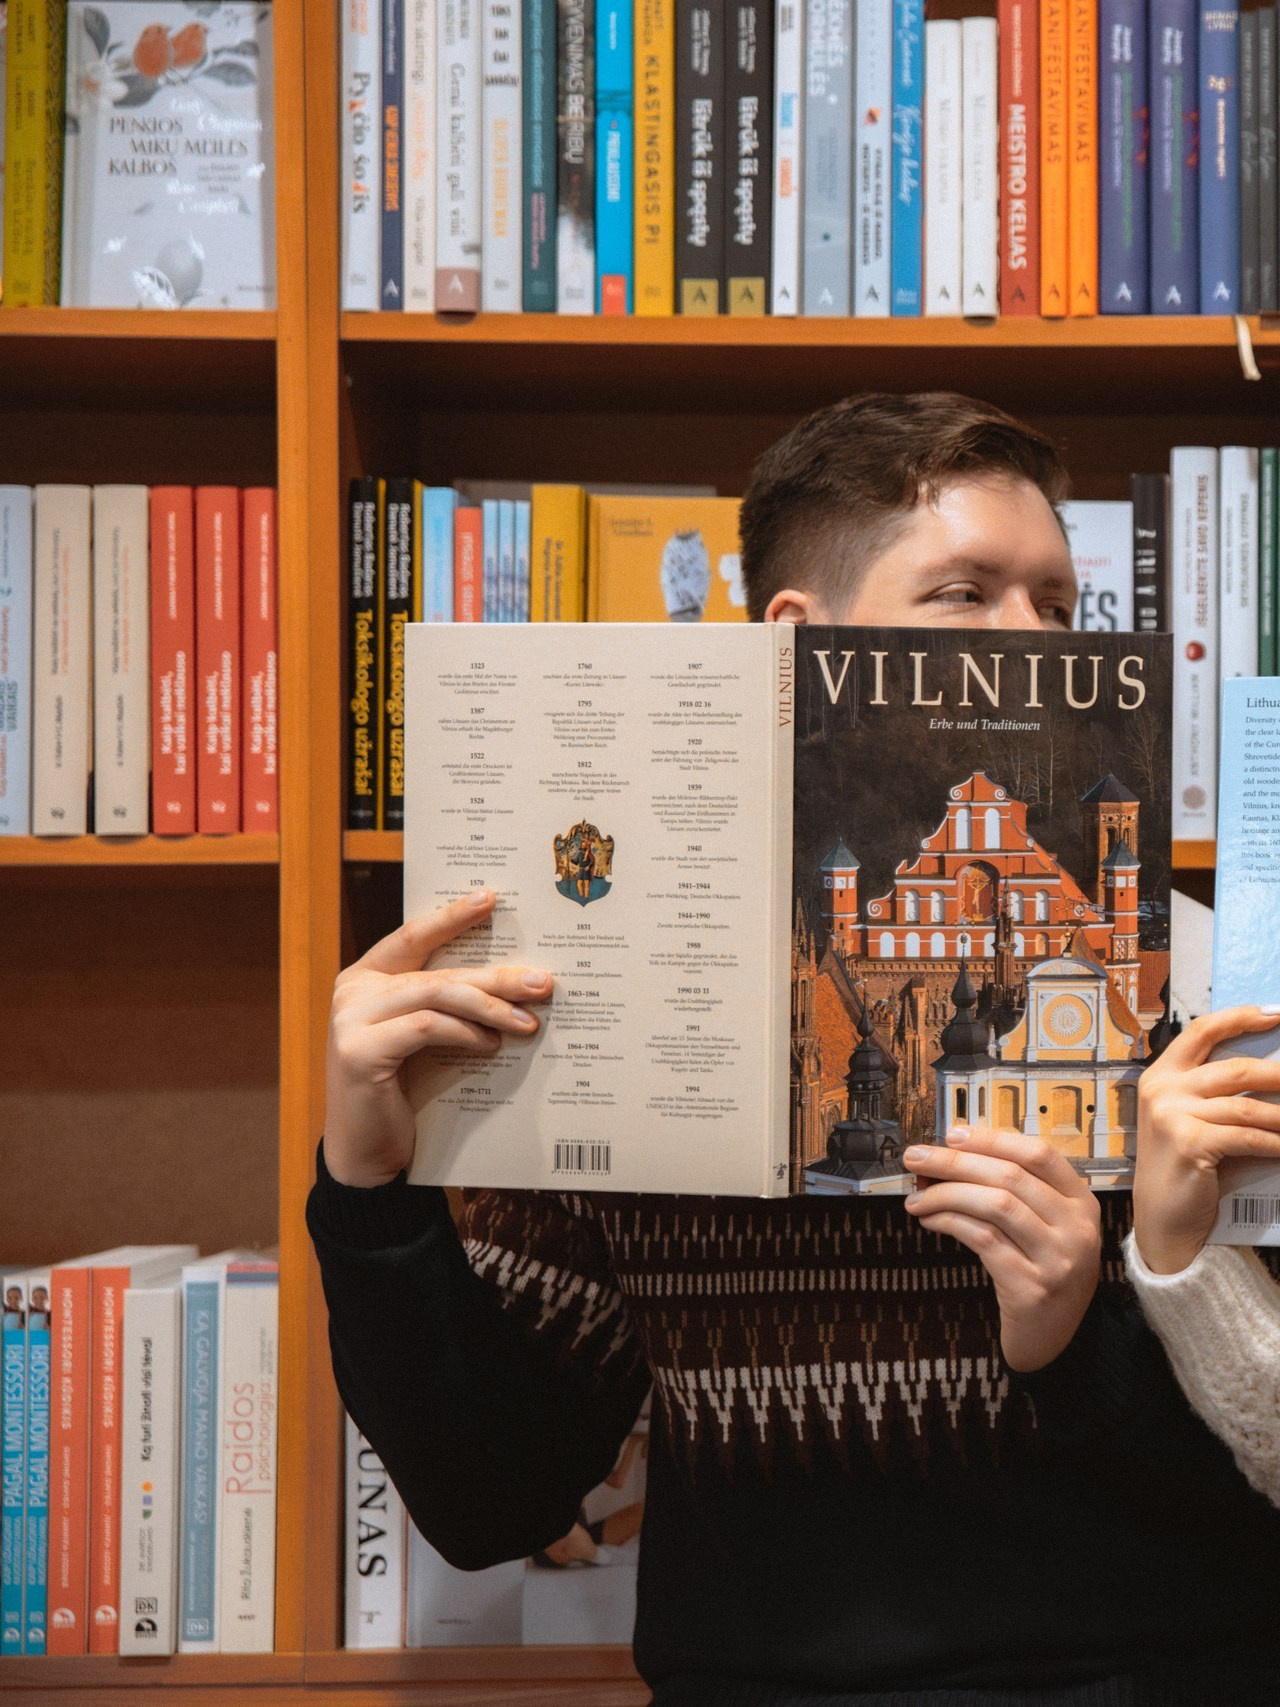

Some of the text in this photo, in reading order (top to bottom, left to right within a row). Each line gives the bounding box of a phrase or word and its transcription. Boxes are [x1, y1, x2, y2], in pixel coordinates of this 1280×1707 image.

[645, 54, 661, 214] KLASTINGASIS
[1008, 103, 1026, 270] MEISTRO KELIAS
[470, 662, 485, 670] 1323
[779, 647, 792, 727] VILNIUS
[813, 650, 1146, 710] VILNIUS
[351, 609, 375, 796] Toksikologo užrašai
[470, 707, 485, 715] 1387
[930, 718, 1040, 731] Erbe und Traditionen
[1245, 716, 1276, 725] Diversity
[687, 738, 703, 746] 1920
[470, 752, 485, 760] 1522
[469, 834, 485, 842] 1569
[576, 923, 591, 931] 1831
[685, 1024, 701, 1032] 1991
[685, 1085, 700, 1093] 1994
[5, 1344, 25, 1507] PAGAL MONTESSORI
[29, 1344, 49, 1507] PAGAL MONTESSORI
[225, 1383, 264, 1494] Raidos
[357, 1436, 389, 1577] UNAS
[135, 1597, 157, 1615] DK
